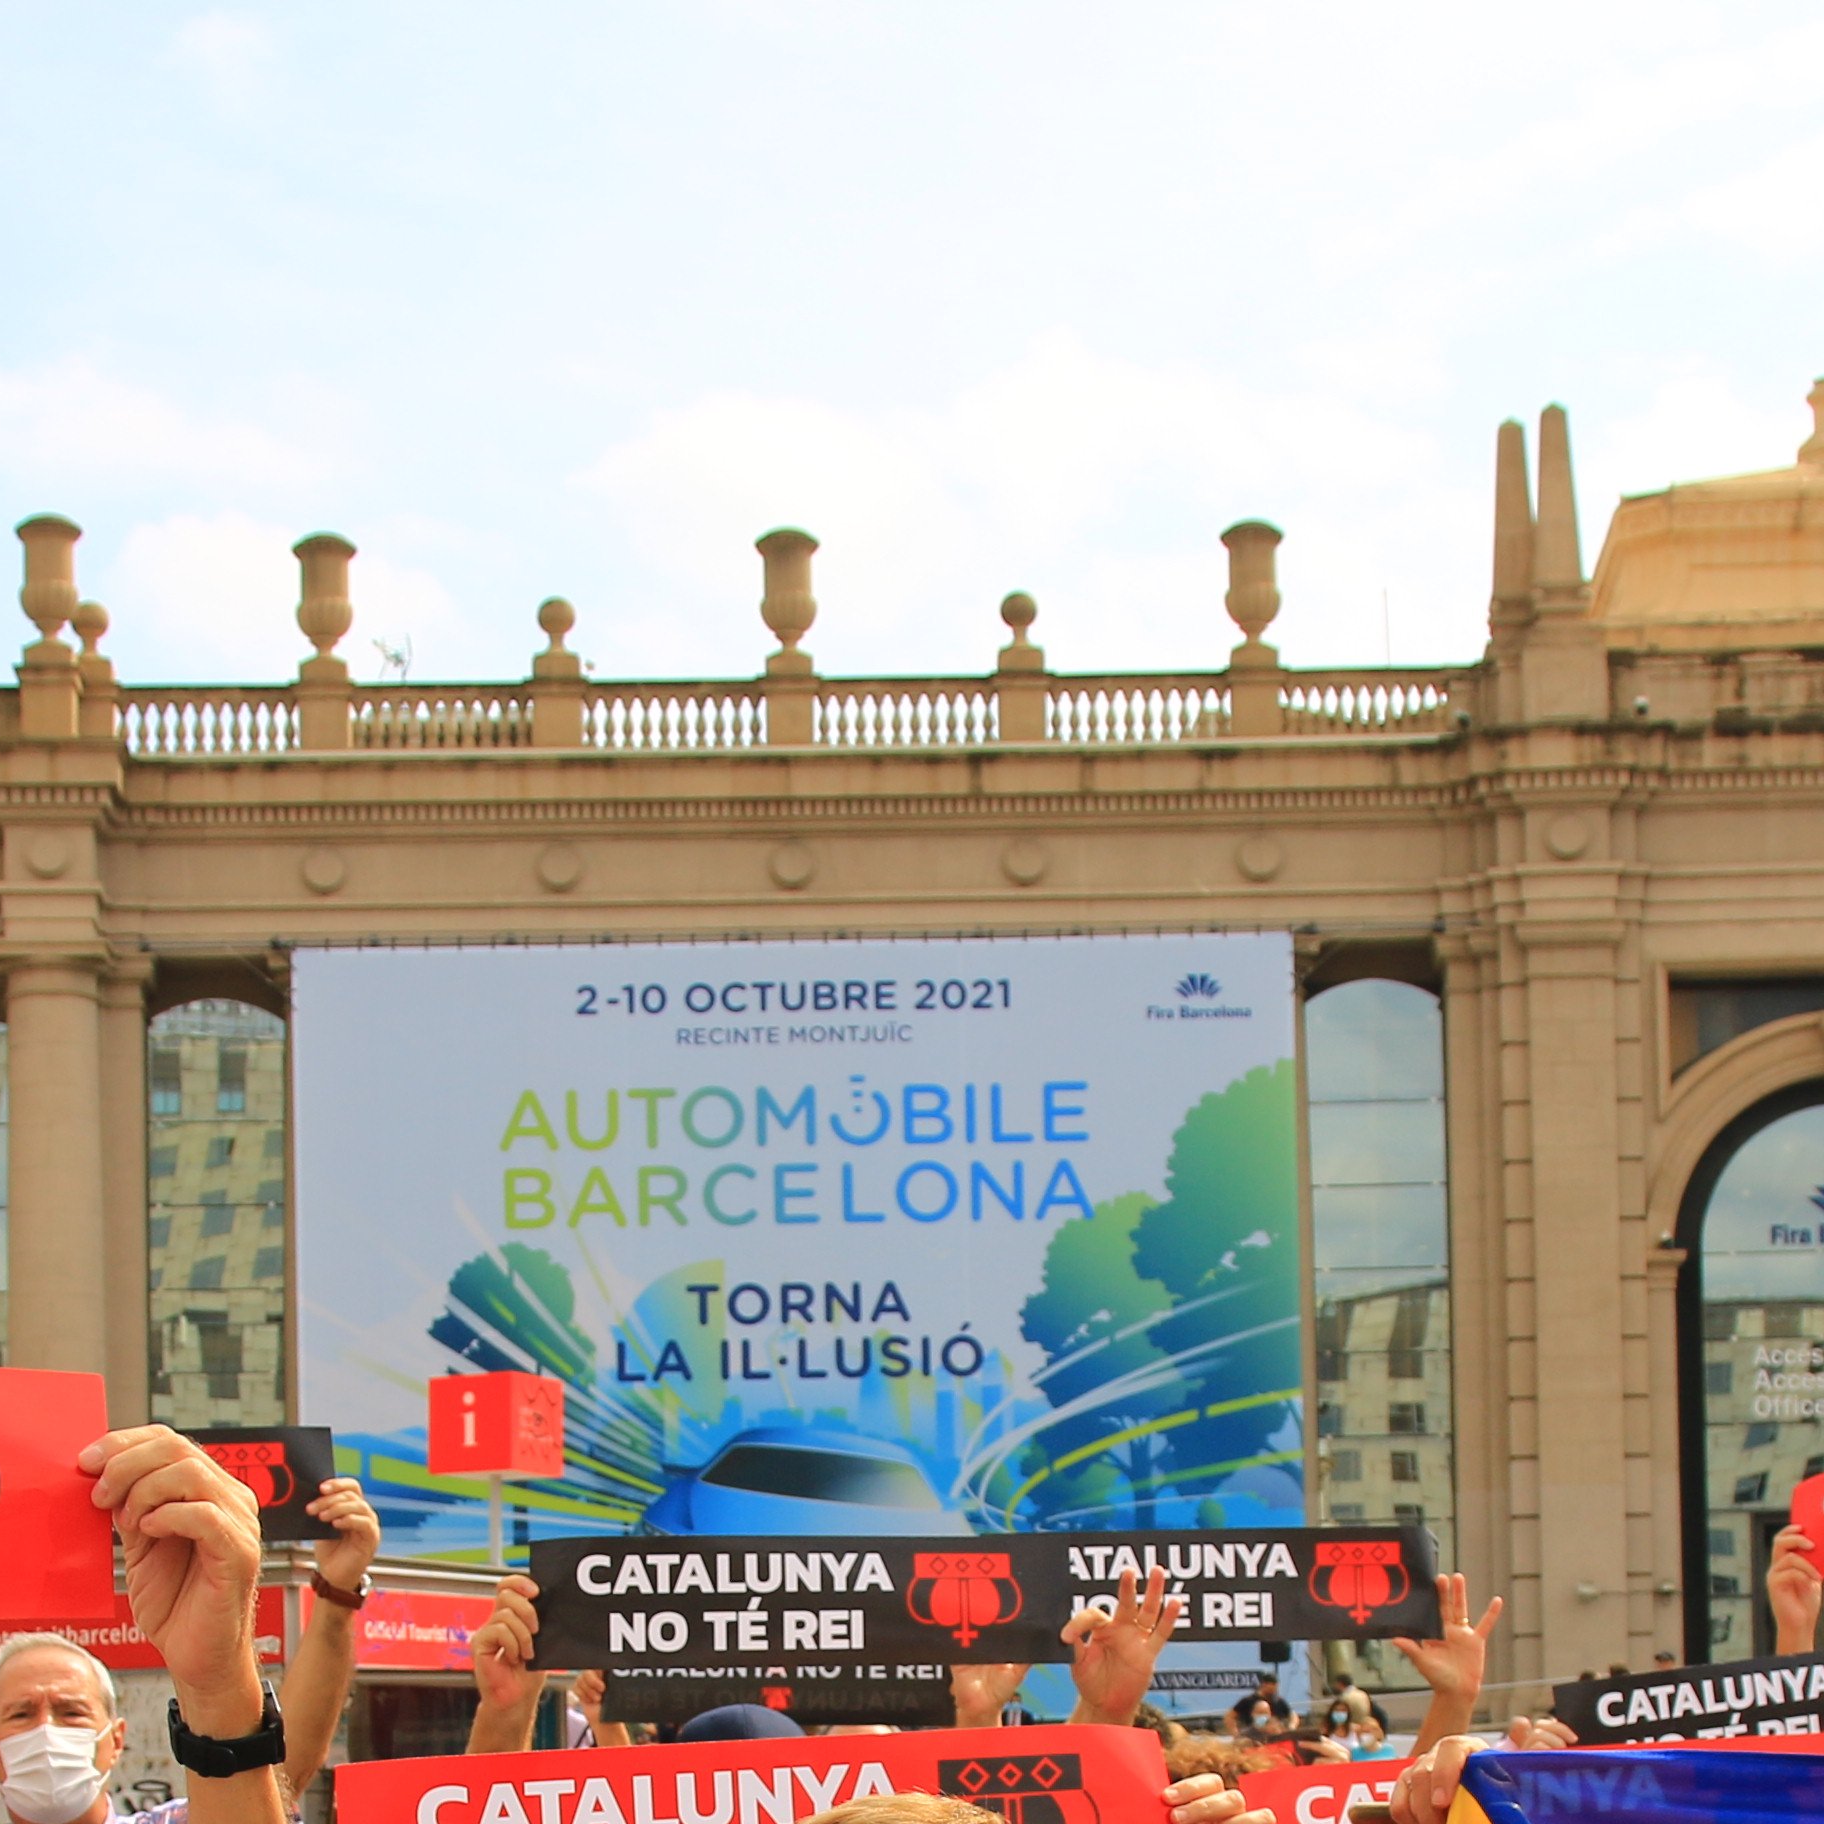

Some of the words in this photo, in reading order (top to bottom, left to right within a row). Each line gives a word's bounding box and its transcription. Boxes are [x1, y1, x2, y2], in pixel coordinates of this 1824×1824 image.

[685, 980, 898, 1013] OCTUBRE
[915, 978, 1012, 1010] 2021
[1146, 1005, 1174, 1020] Fira
[1180, 1004, 1253, 1020] Barcelona
[677, 1026, 780, 1046] RECINTE
[502, 1159, 1096, 1229] BARCELONA
[1771, 1225, 1811, 1244] Fira
[687, 1282, 911, 1326] TORNA
[617, 1339, 693, 1383] LA
[576, 1552, 894, 1595] CATALUNYA
[1069, 1543, 1299, 1581] ATALUNYA
[608, 1612, 689, 1653] NO
[704, 1597, 770, 1652] TÉ
[783, 1609, 865, 1649] REI
[1202, 1592, 1275, 1628] REI
[1161, 1671, 1262, 1691] VANGUARDIA
